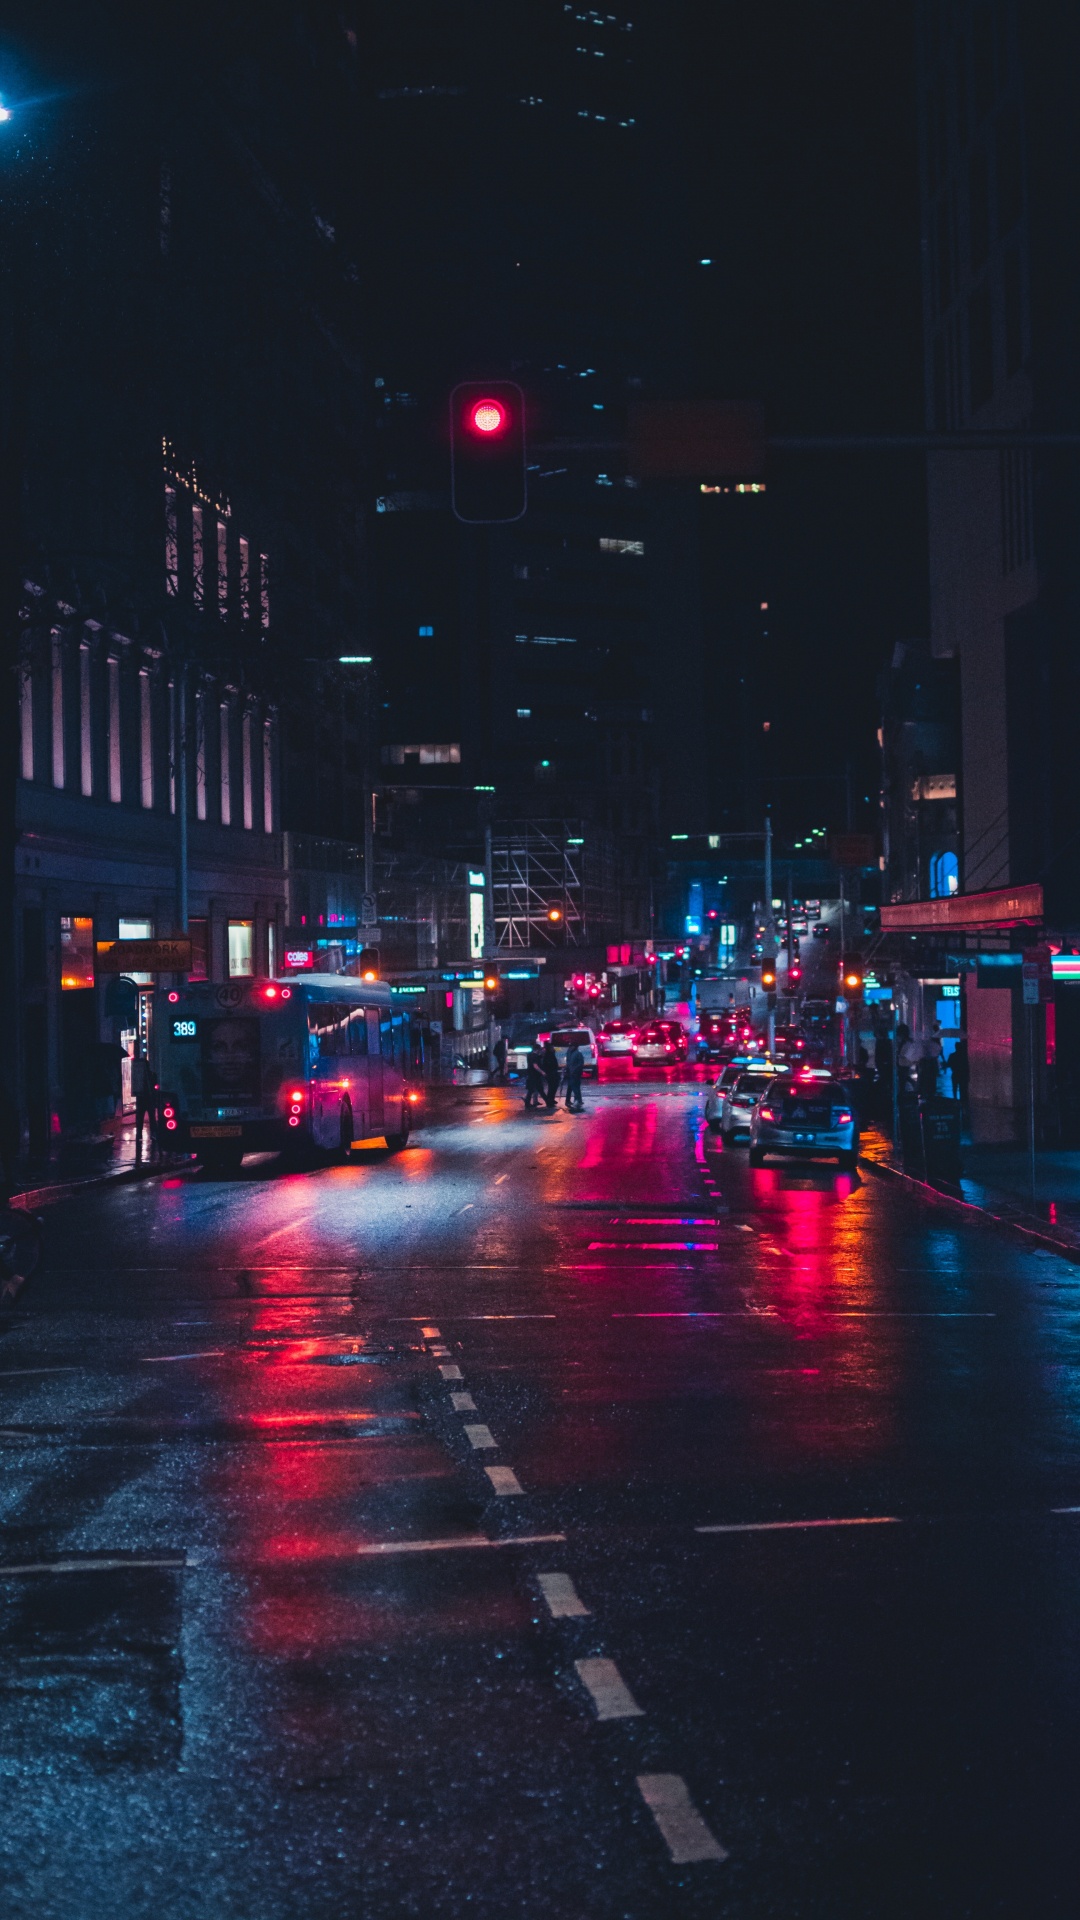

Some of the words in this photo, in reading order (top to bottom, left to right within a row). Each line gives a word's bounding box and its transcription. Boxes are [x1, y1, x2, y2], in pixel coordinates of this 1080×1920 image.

[109, 944, 179, 955] ROADWORK
[287, 951, 308, 961] coles
[220, 987, 239, 1001] 40
[173, 1021, 197, 1037] 389
